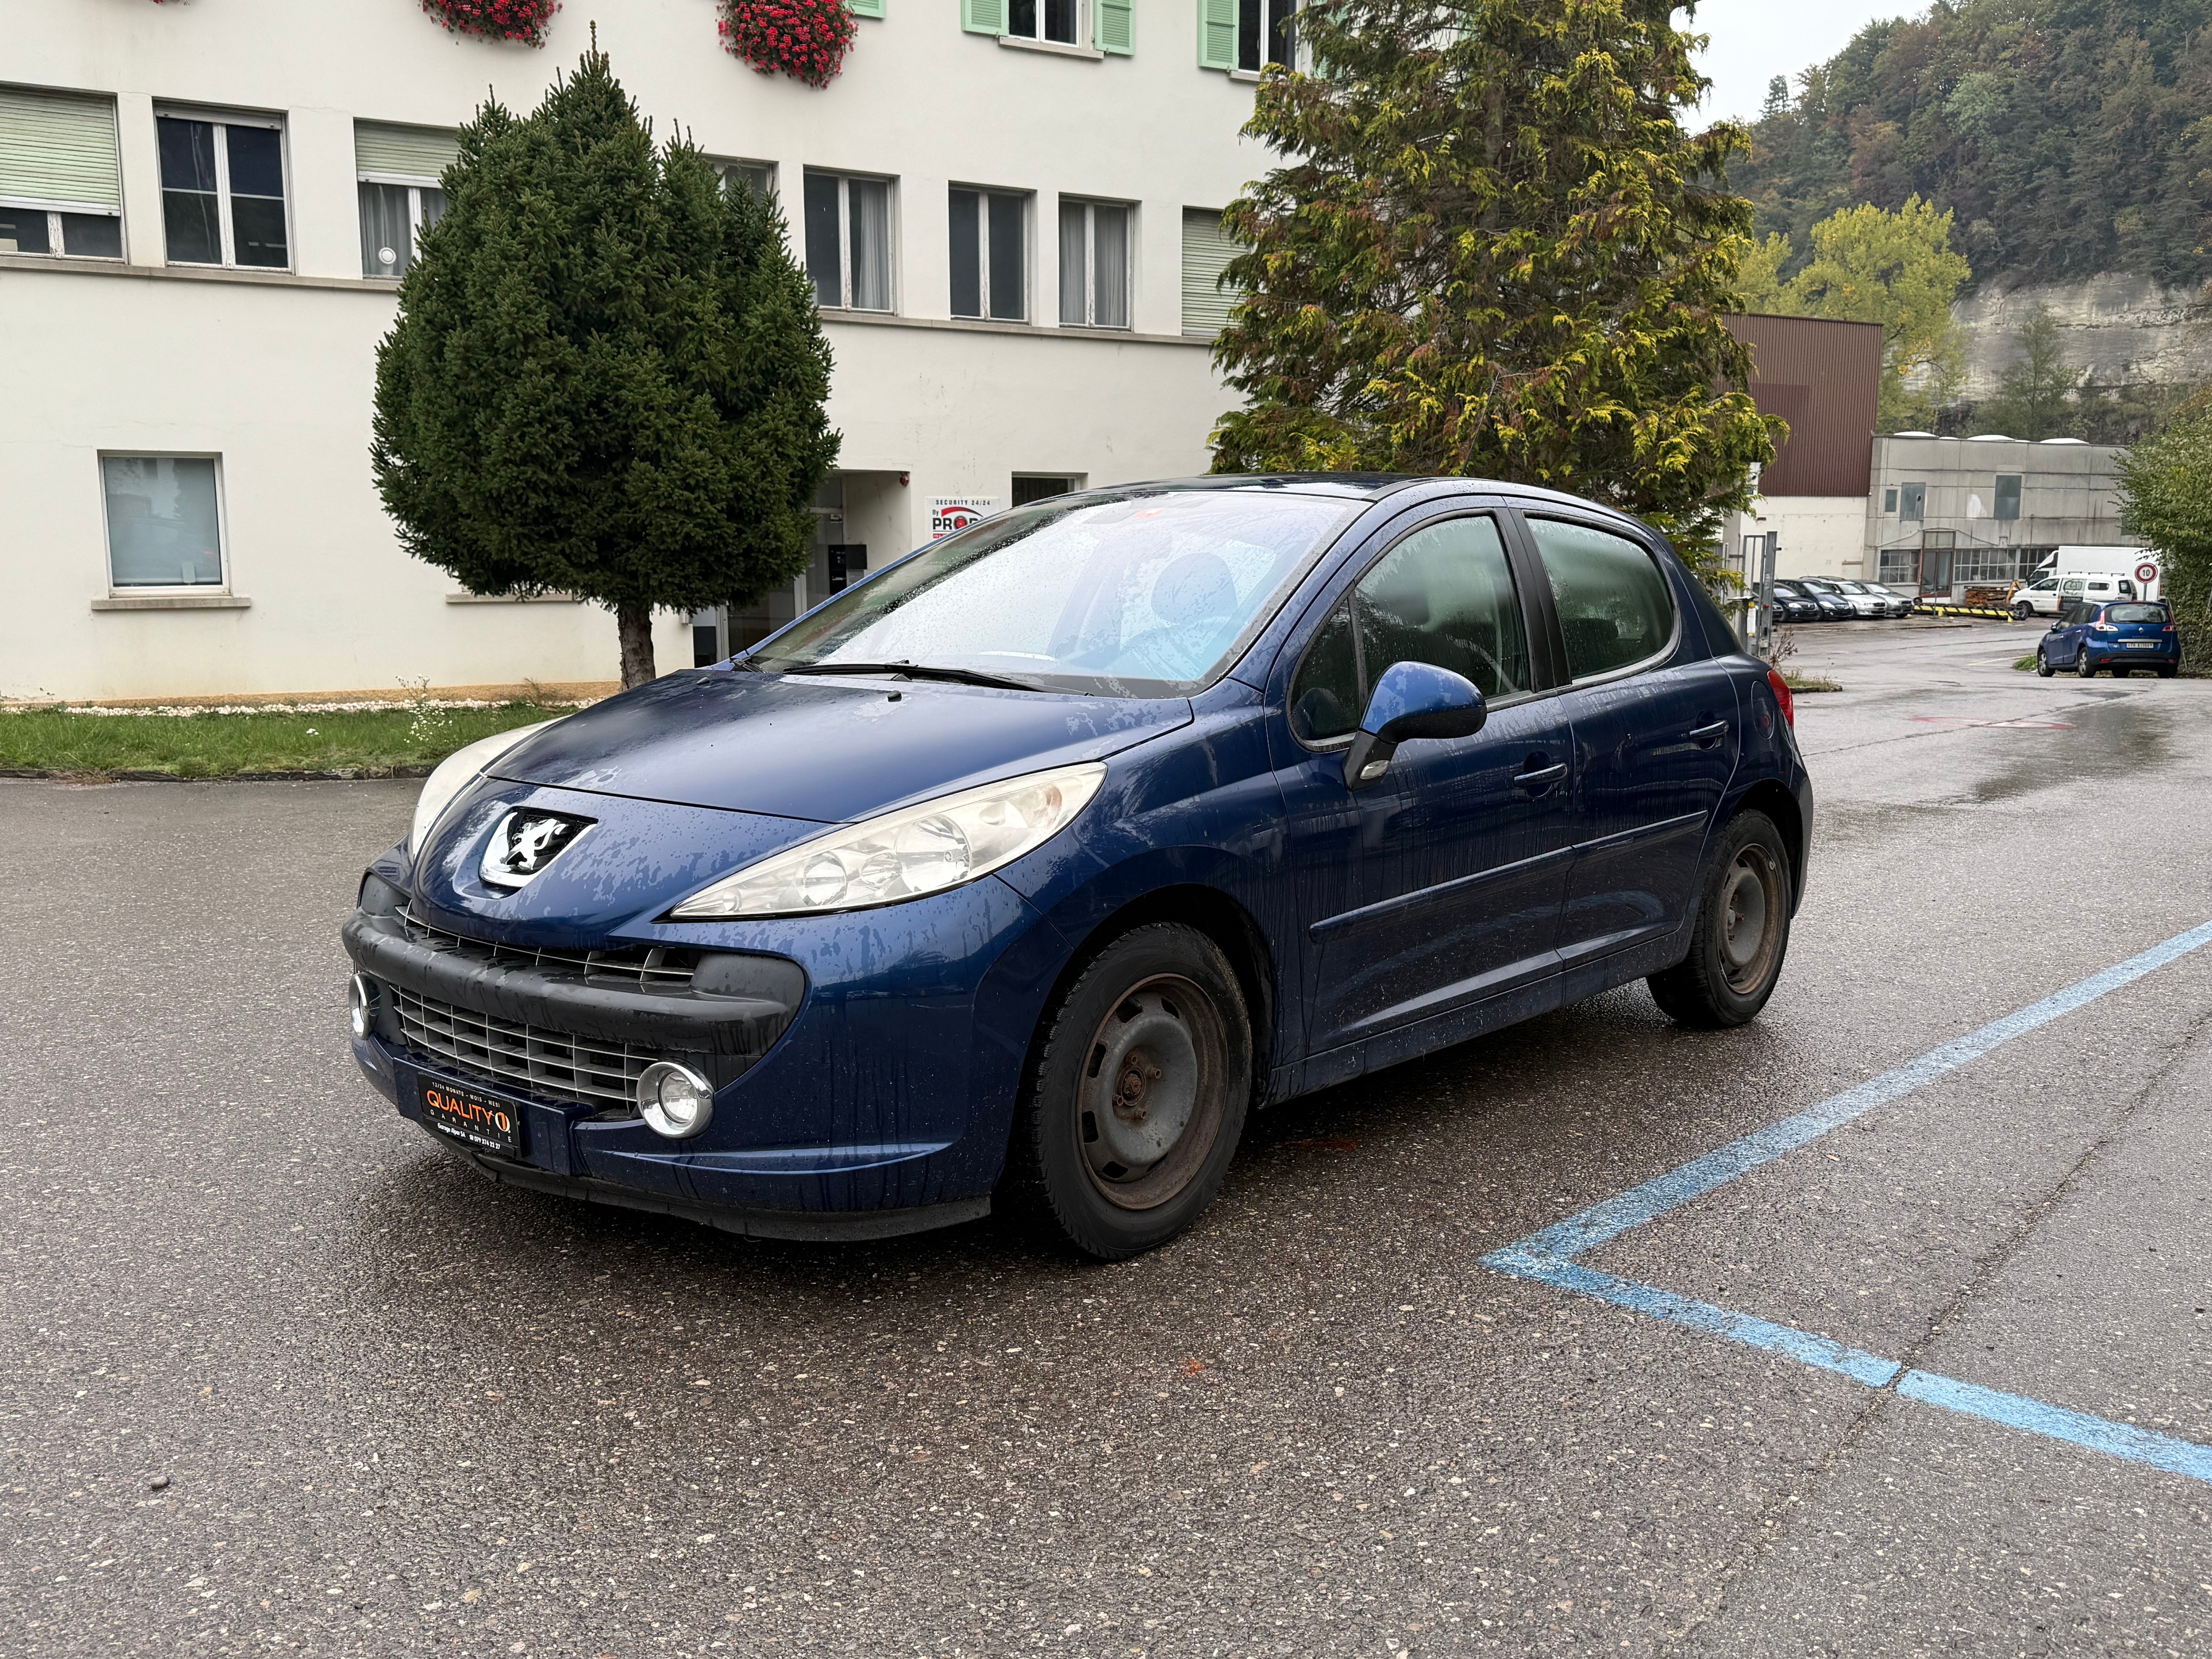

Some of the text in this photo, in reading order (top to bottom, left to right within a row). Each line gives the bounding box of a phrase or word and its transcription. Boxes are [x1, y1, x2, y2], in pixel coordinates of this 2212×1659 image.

[432, 1082, 445, 1090] 12/24
[446, 1086, 464, 1097] MONATE
[470, 1094, 483, 1103] MOIS
[430, 1109, 512, 1142] GARANTIE
